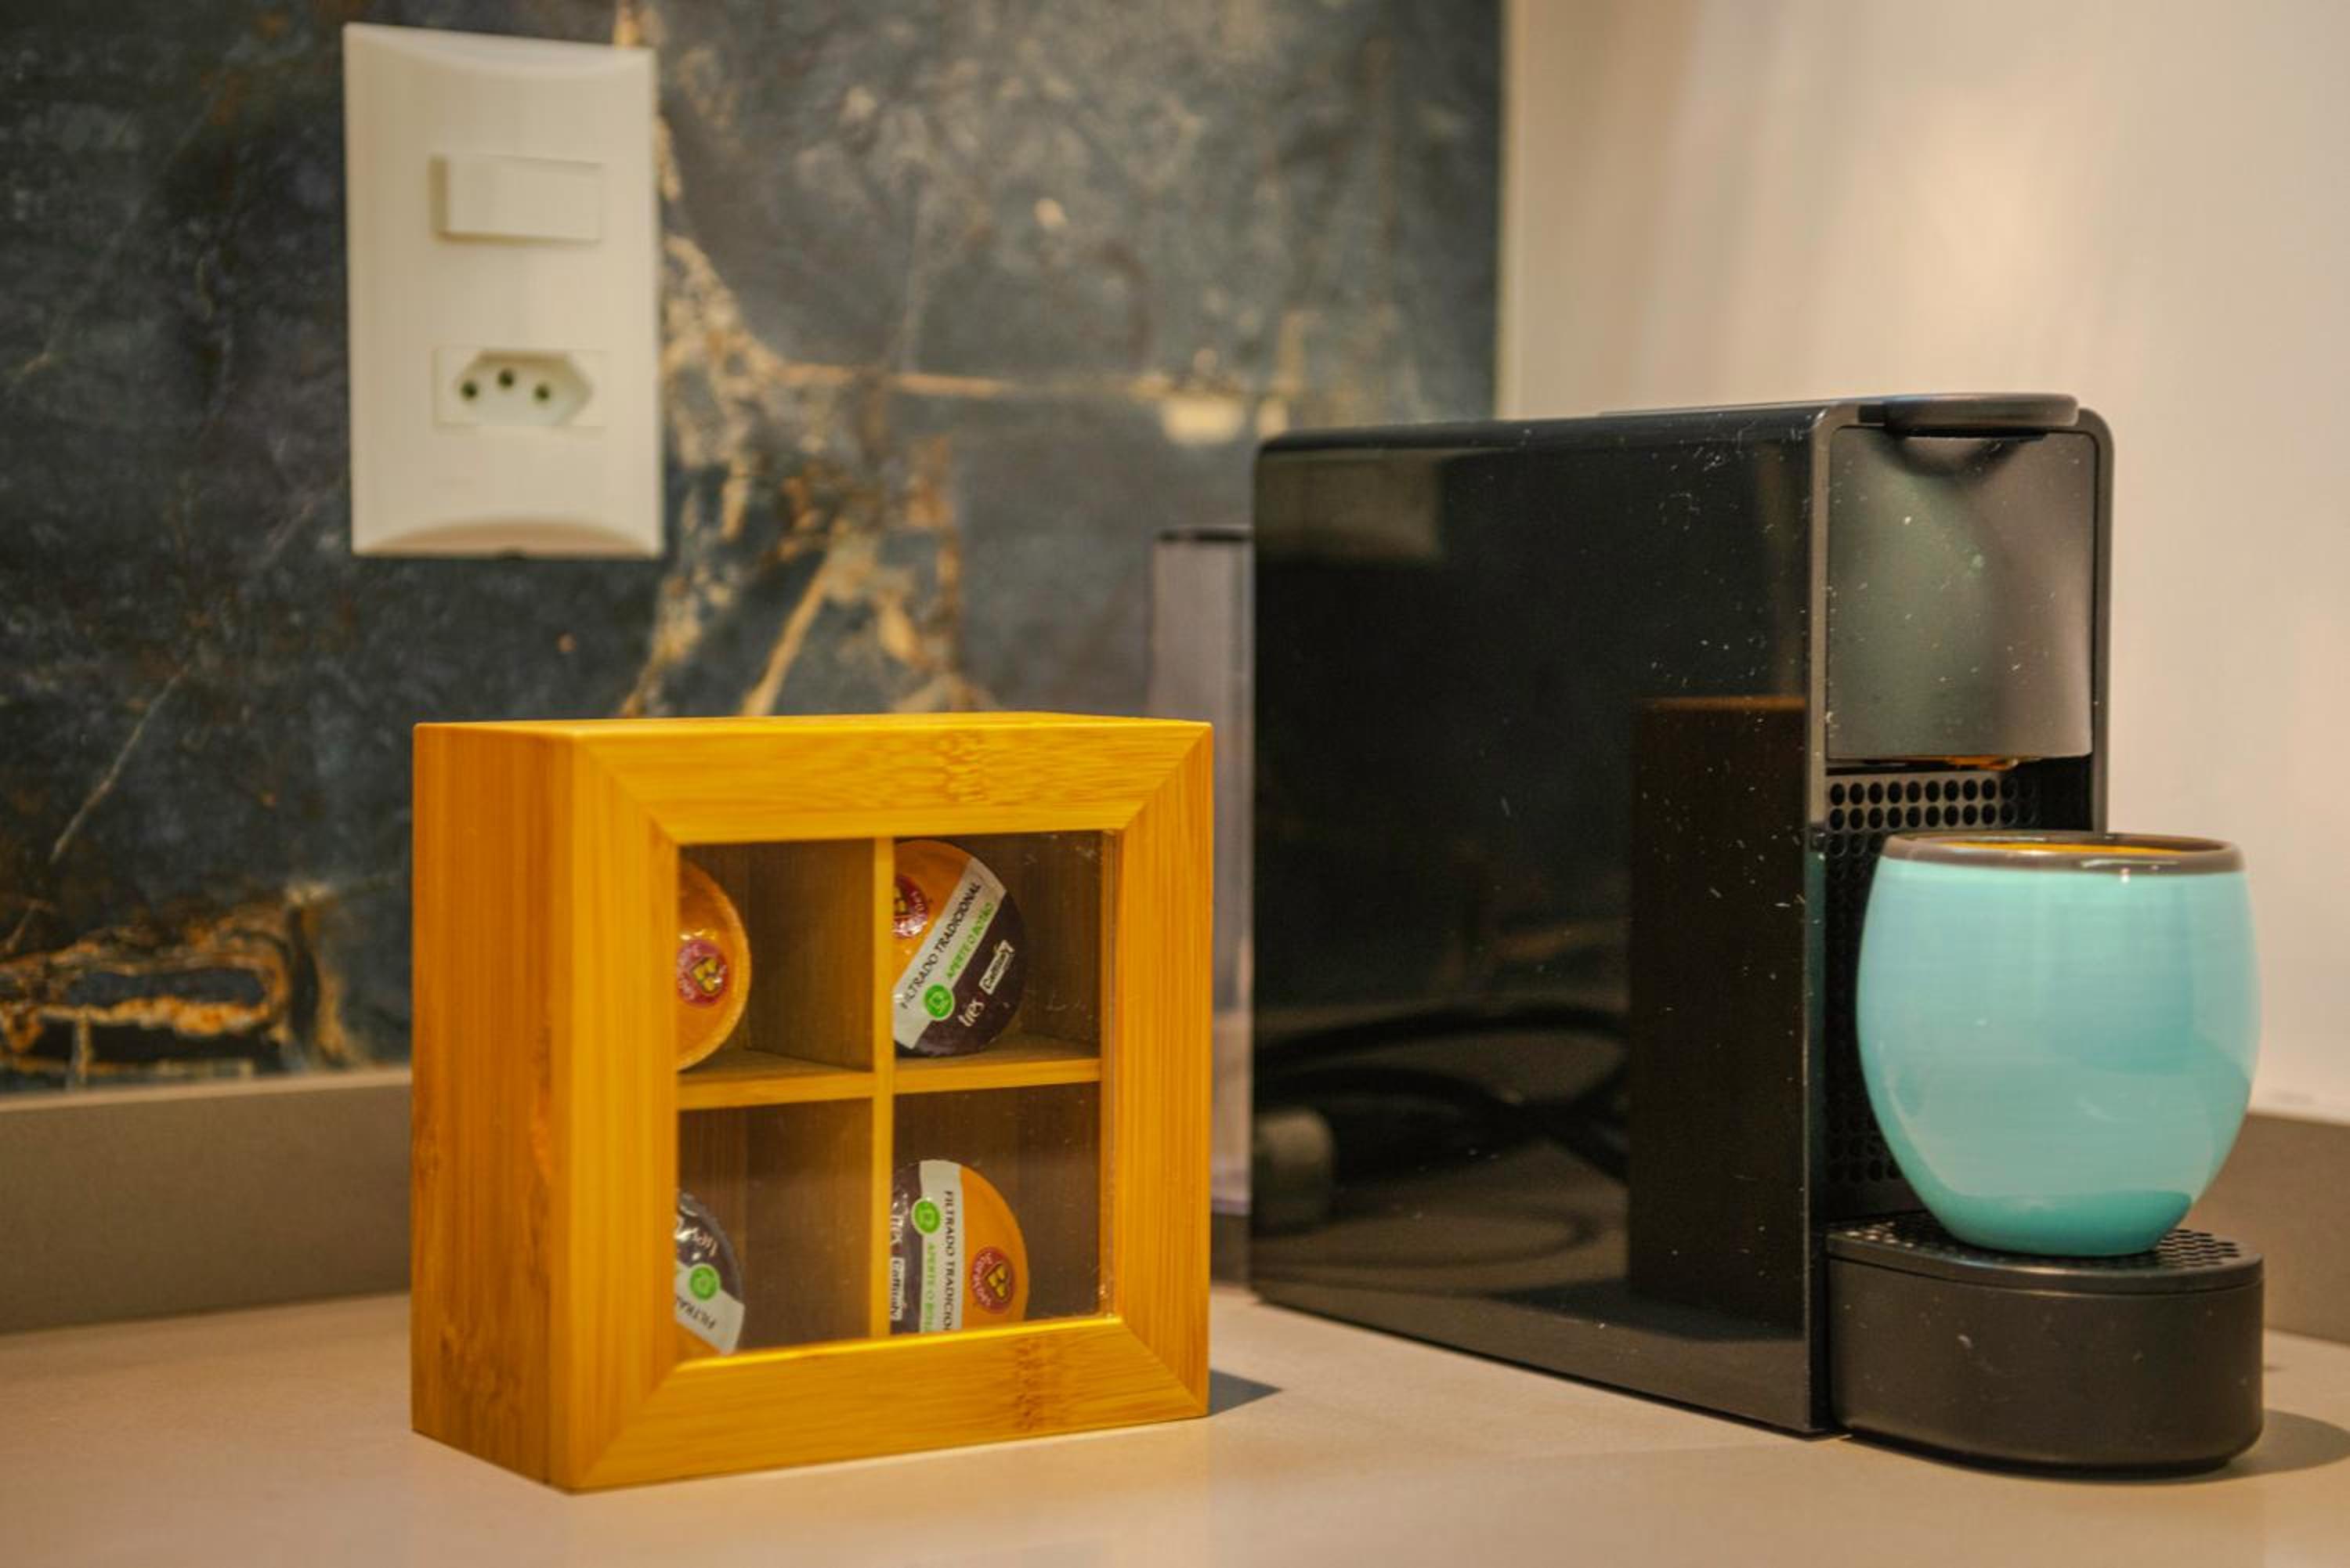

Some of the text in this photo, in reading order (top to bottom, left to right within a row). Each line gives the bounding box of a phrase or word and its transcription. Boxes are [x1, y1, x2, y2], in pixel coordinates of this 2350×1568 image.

[901, 953, 938, 1009] FILTRADO
[933, 883, 982, 953] TRADICIONAL
[943, 1190, 955, 1331] FILTRADO TRADICIO
